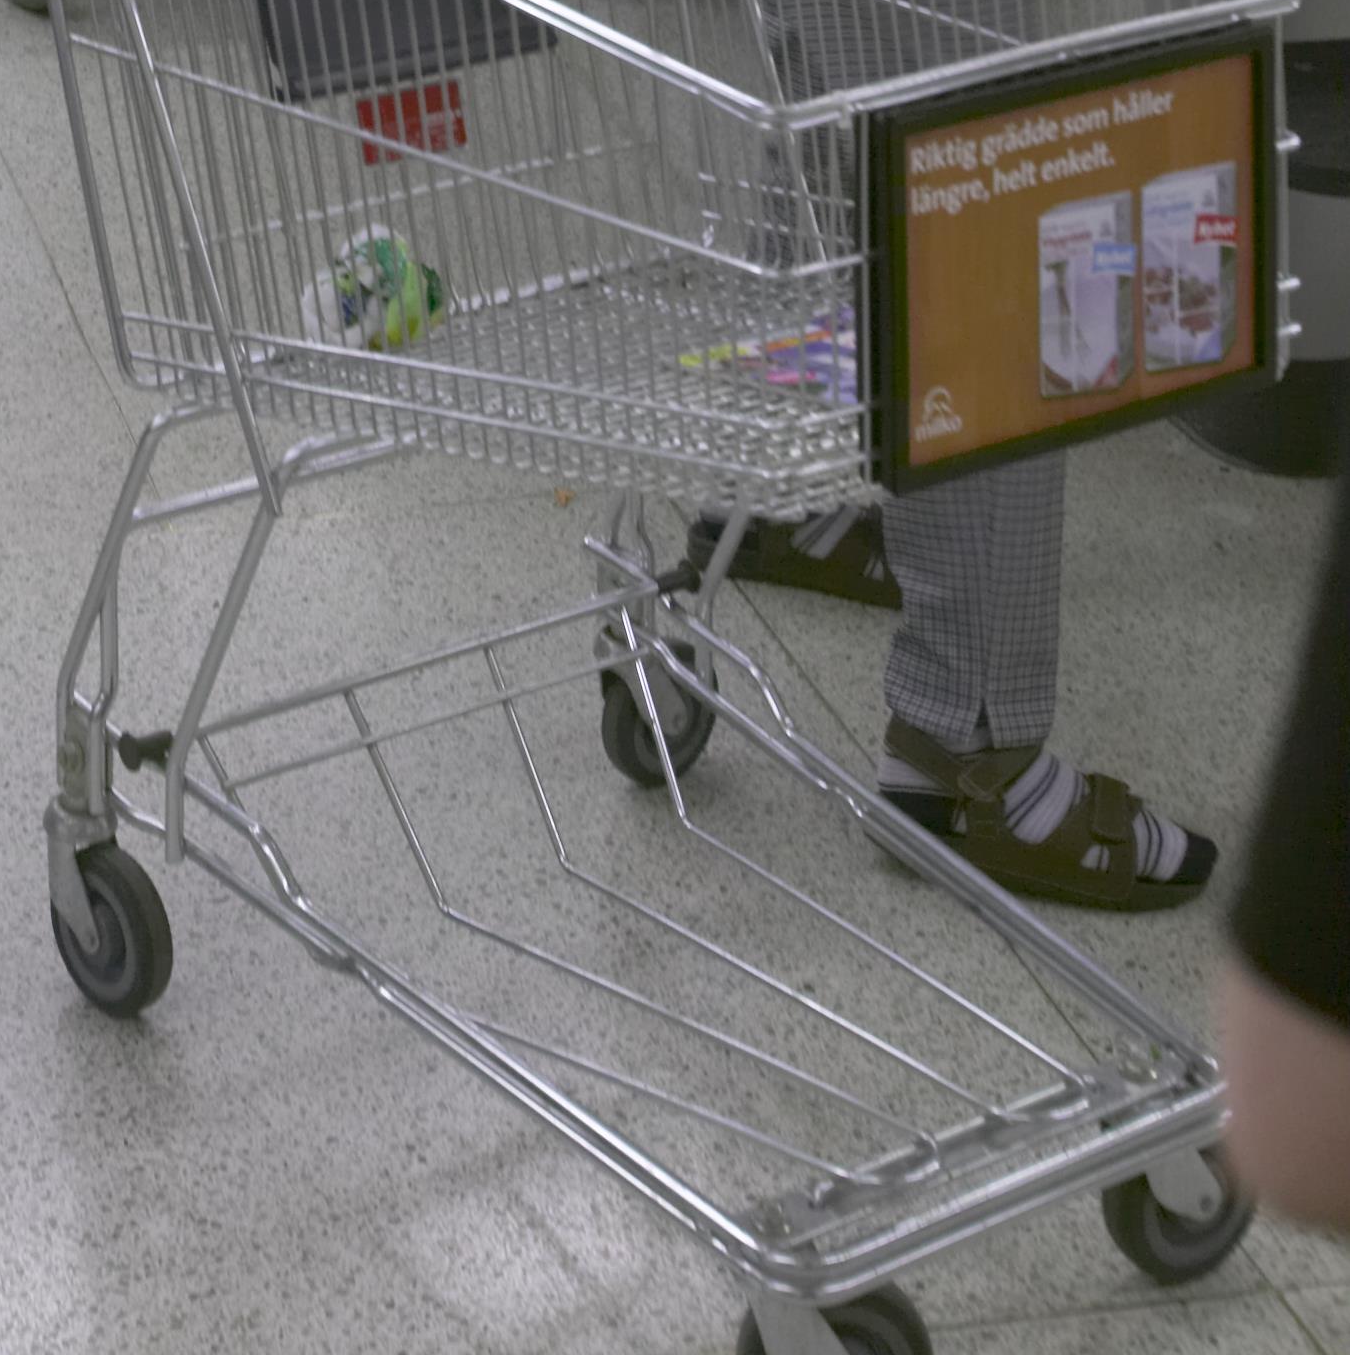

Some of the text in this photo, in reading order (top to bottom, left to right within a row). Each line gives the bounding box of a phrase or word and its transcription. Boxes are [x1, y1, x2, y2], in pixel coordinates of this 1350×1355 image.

[910, 89, 1175, 175] Riktig grädde som håller
[910, 141, 1116, 216] längre, helt enkelt.
